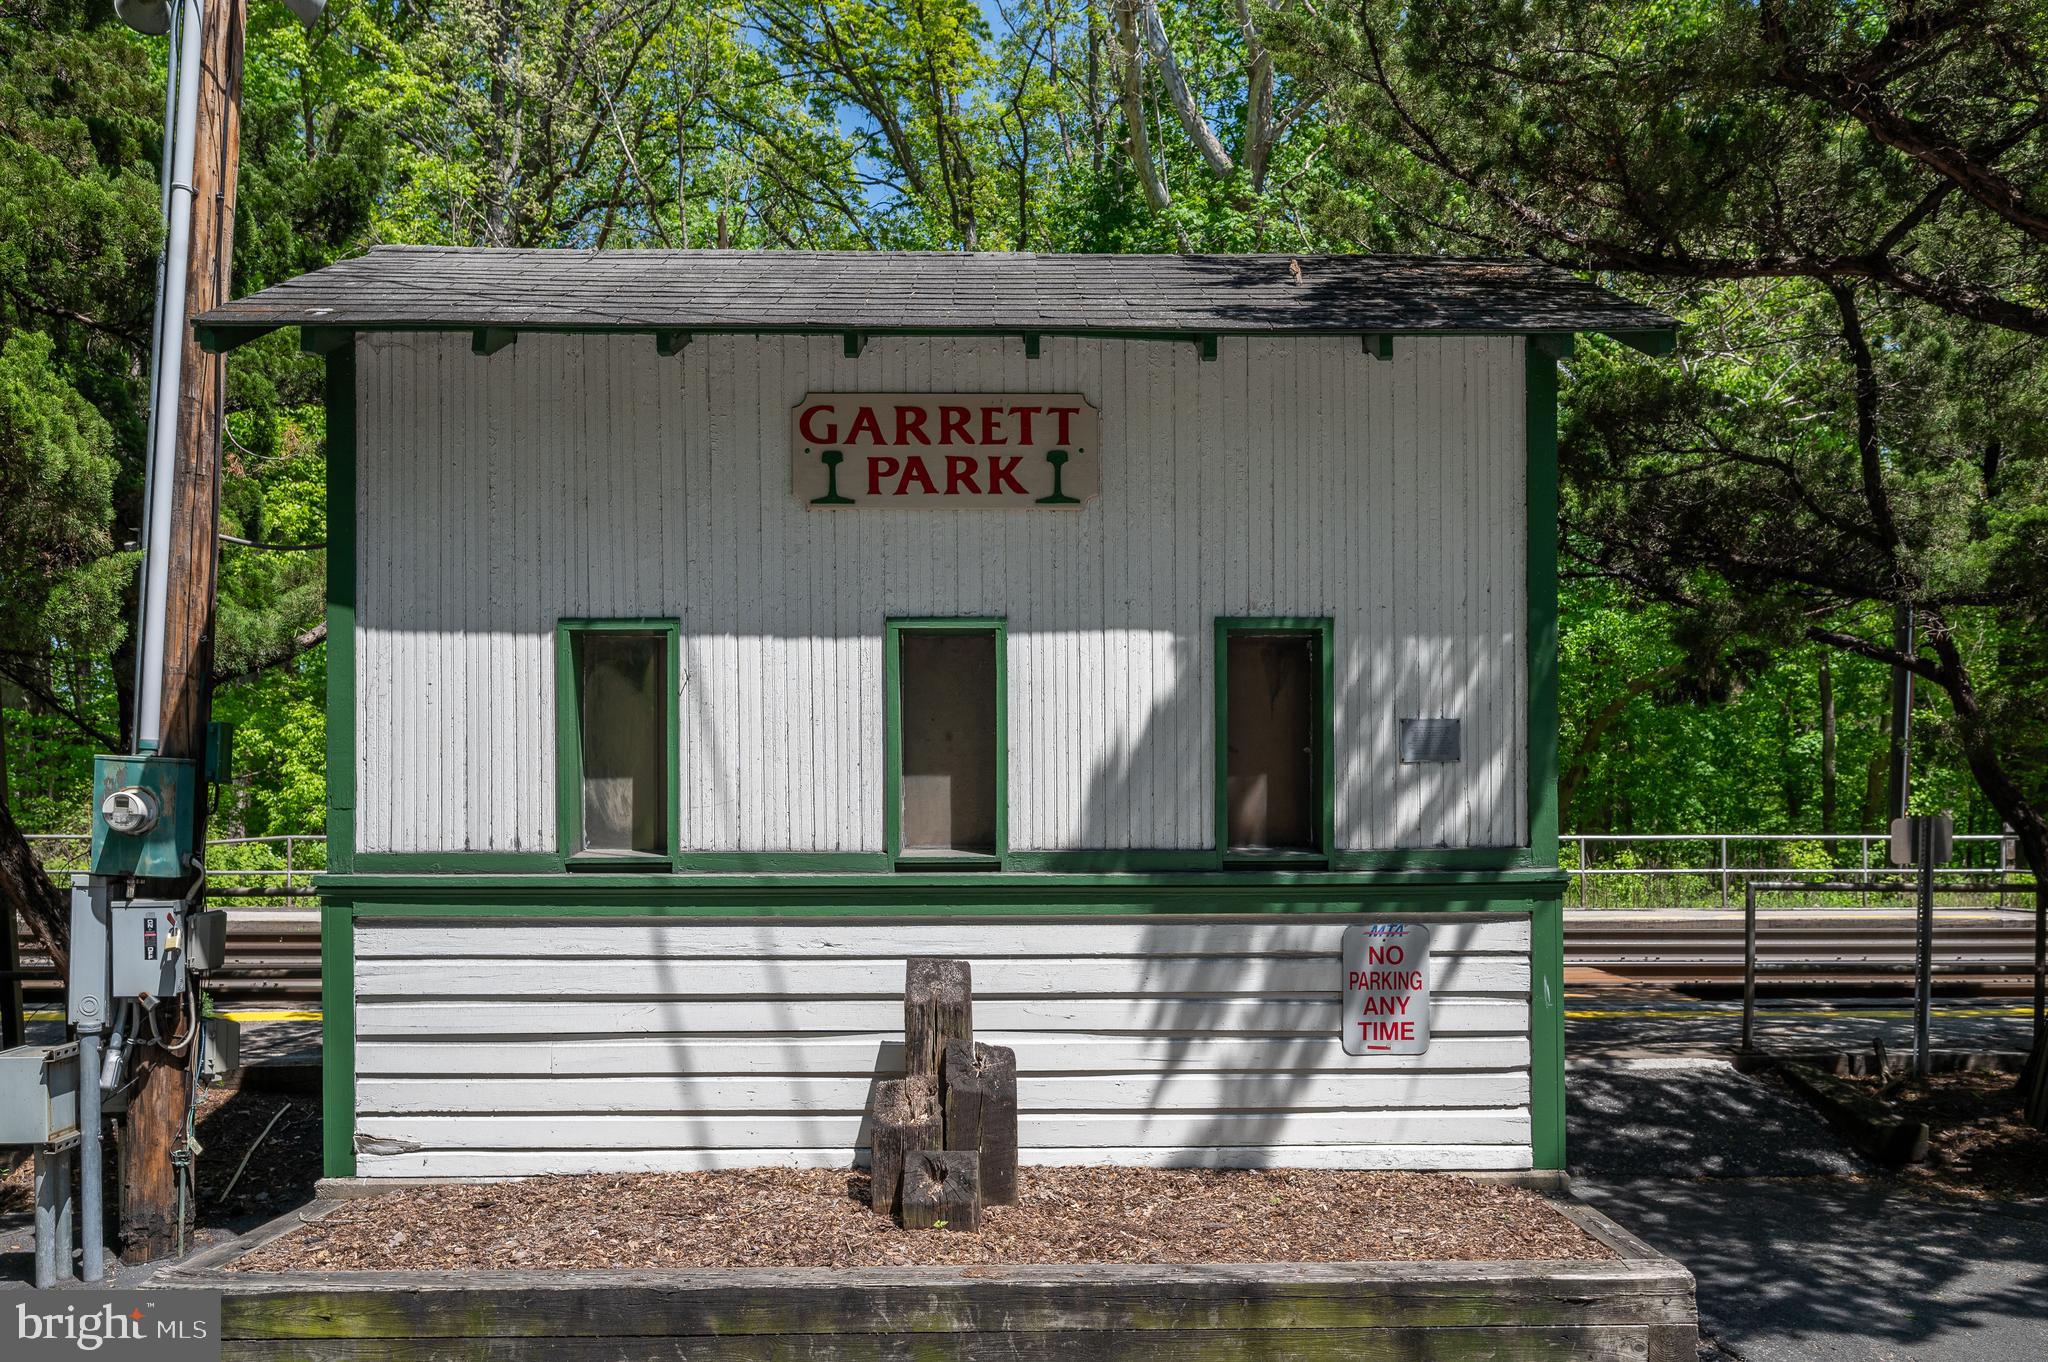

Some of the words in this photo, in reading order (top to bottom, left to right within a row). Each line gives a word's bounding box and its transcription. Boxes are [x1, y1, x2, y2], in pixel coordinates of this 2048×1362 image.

[799, 405, 1081, 446] GARRETT
[865, 455, 1030, 496] PARK
[1368, 923, 1405, 937] MTA
[1368, 945, 1404, 965] NO
[1349, 971, 1423, 991] PARKING
[1363, 996, 1411, 1016] ANY
[1357, 1021, 1415, 1041] TIME
